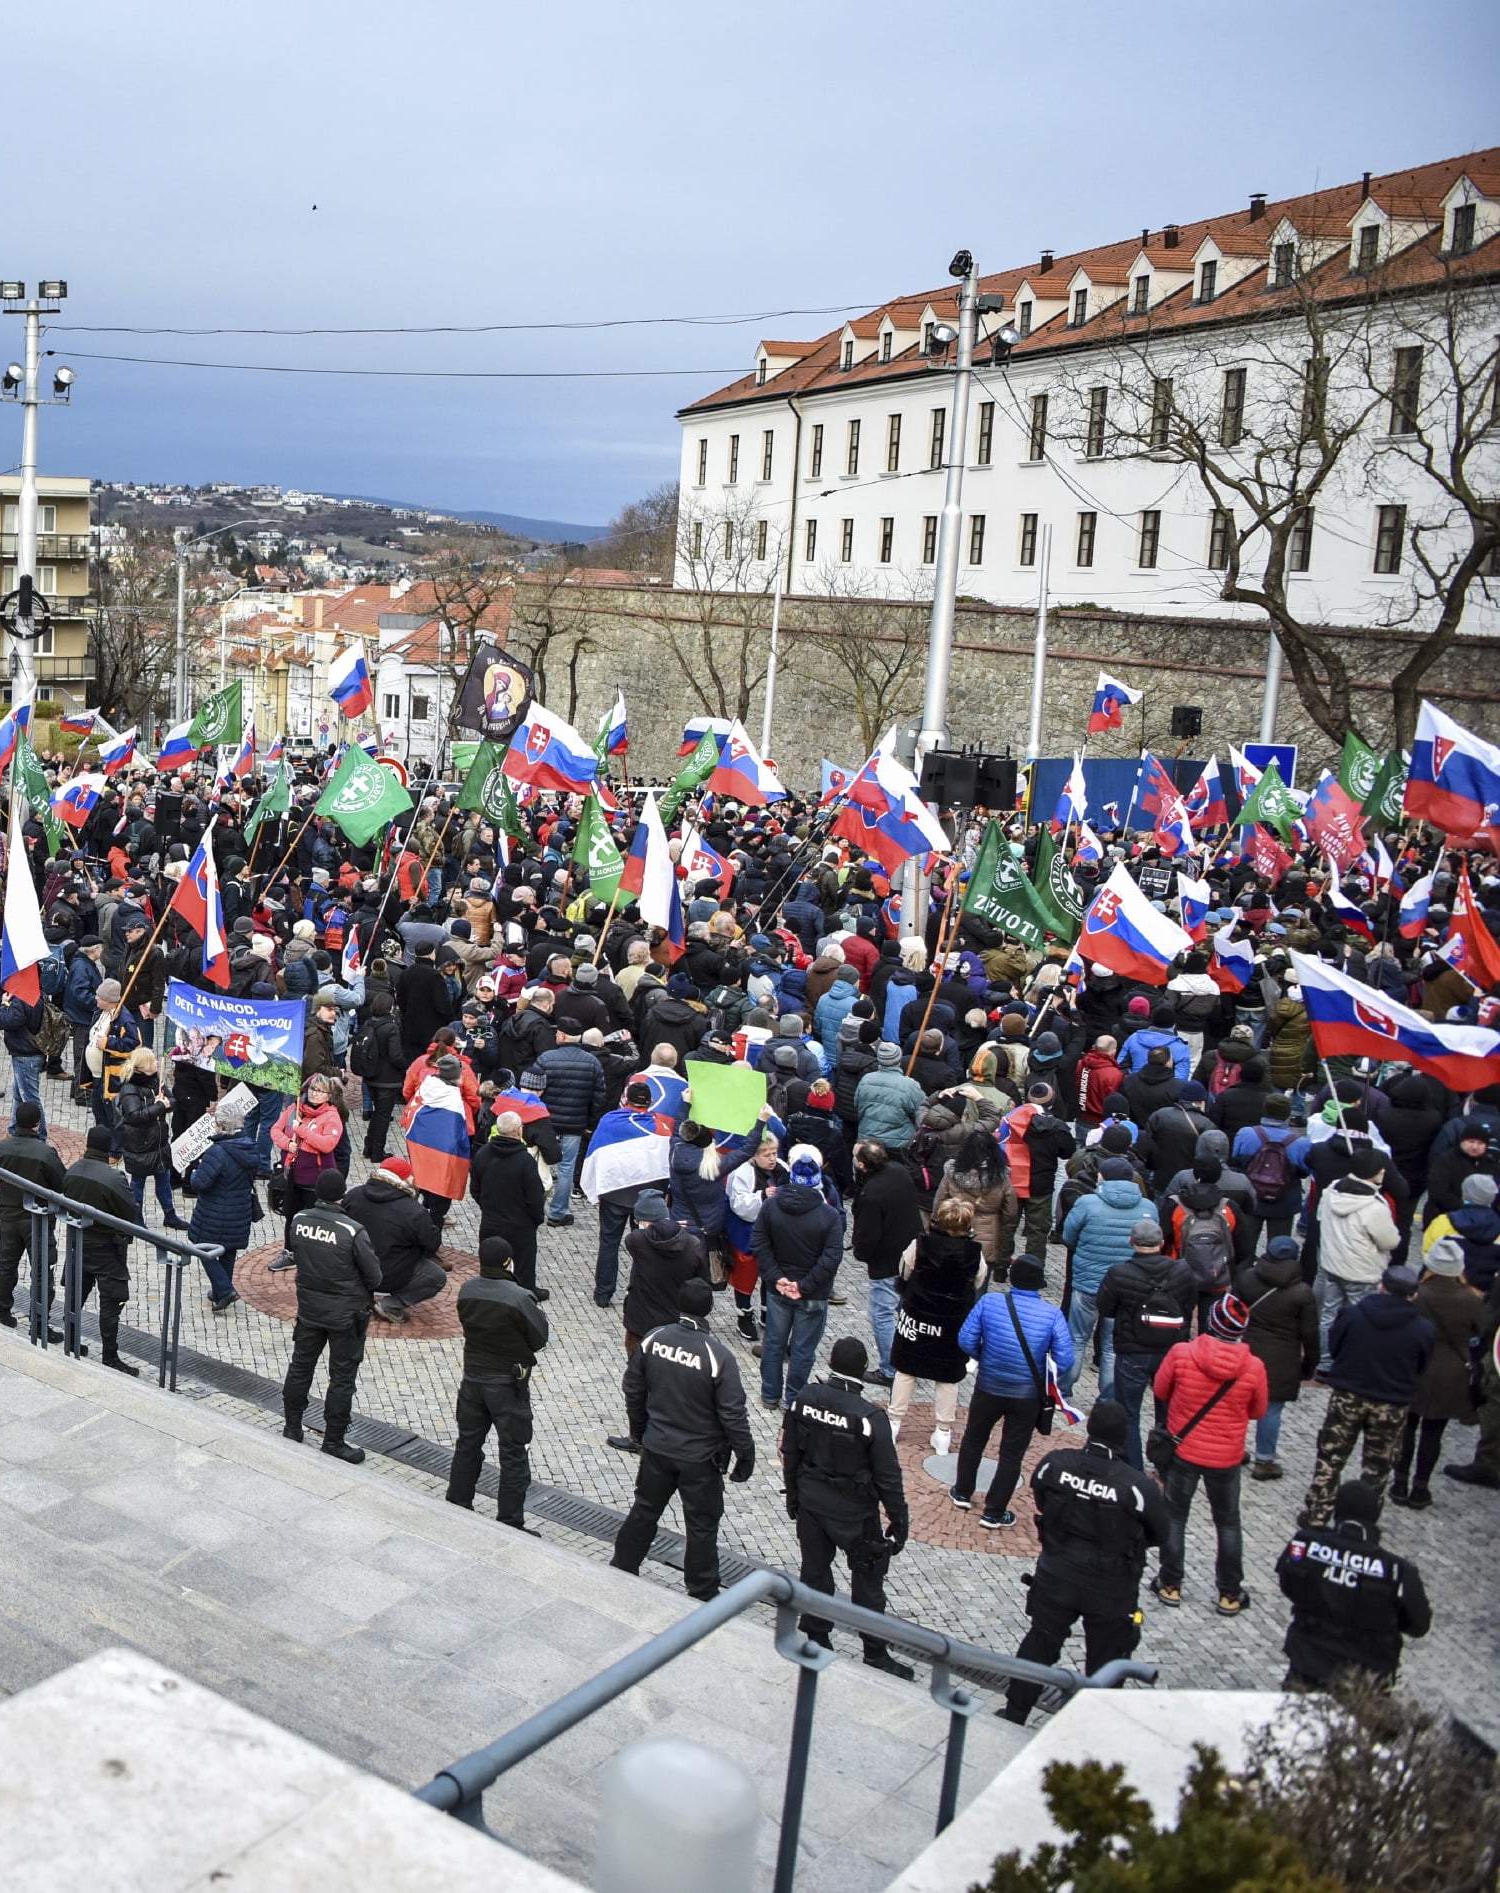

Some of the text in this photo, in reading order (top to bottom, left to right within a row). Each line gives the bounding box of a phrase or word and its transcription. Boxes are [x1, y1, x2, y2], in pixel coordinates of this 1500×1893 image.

[174, 994, 293, 1031] DETI A SLOBODU
[195, 993, 258, 1017] ZA NÁROD,
[296, 1223, 337, 1245] POLÍCIA
[905, 1317, 942, 1337] KLEIN
[652, 1341, 701, 1370] POLÍCIA
[802, 1404, 848, 1429] POLÍCIA
[1059, 1471, 1118, 1502] POLÍCIA
[1307, 1541, 1385, 1575] POLÍCIA
